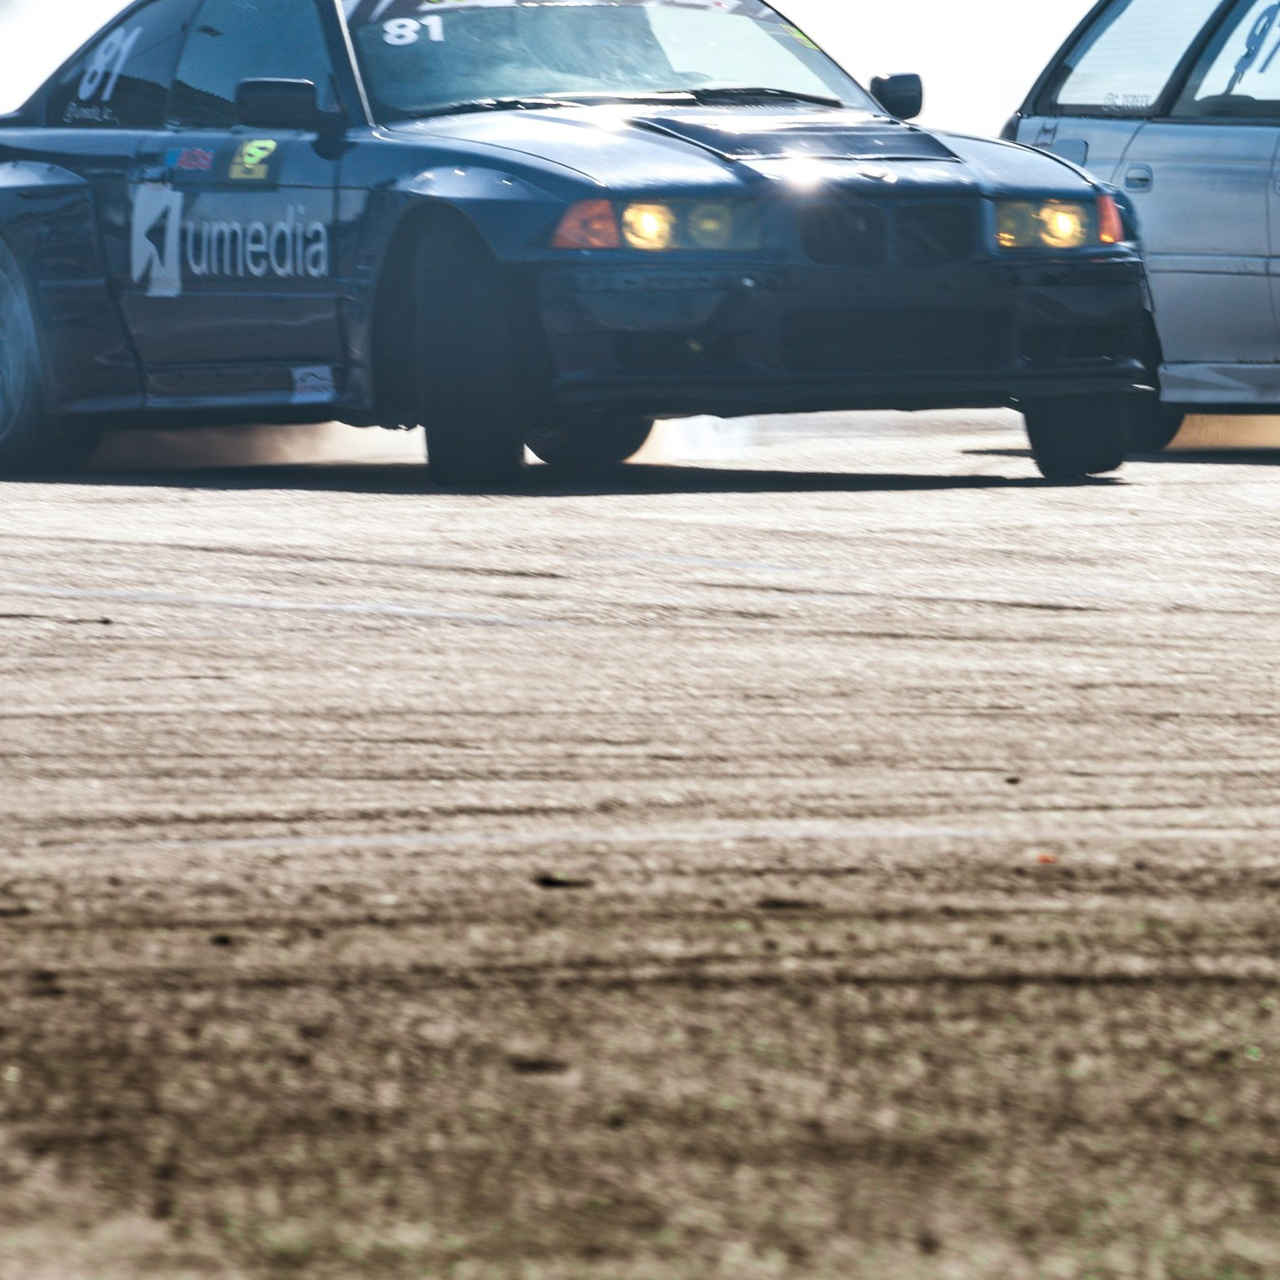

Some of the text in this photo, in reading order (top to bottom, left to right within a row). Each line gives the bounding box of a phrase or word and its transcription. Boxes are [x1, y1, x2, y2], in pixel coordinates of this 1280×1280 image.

[77, 26, 144, 101] 81
[381, 15, 444, 46] 81
[186, 204, 329, 277] umedia
